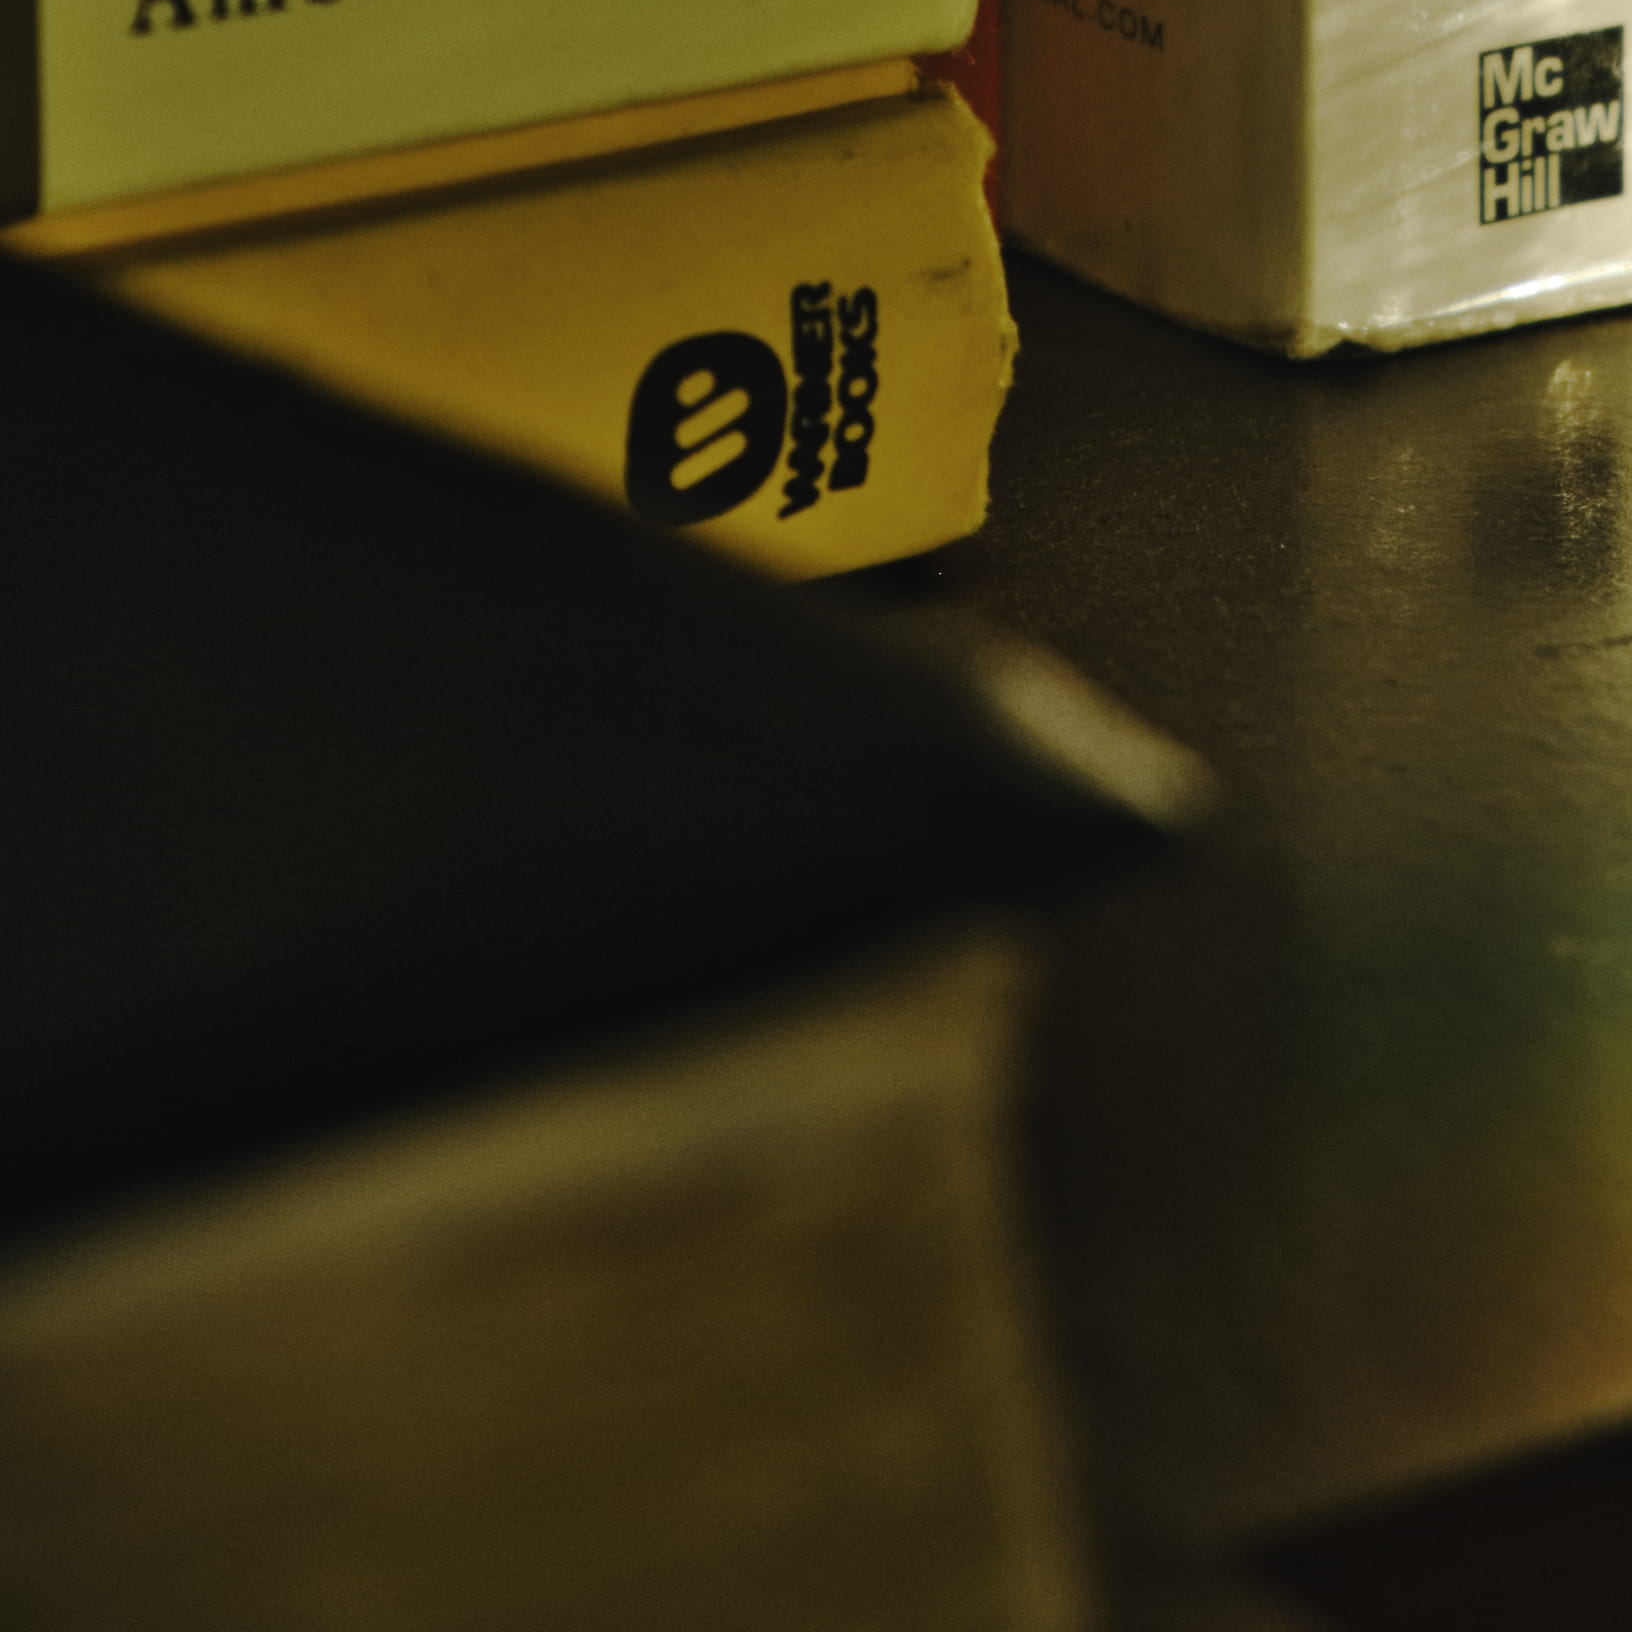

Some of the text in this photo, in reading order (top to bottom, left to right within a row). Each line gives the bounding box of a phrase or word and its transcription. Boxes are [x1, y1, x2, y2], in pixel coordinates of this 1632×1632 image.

[1482, 46, 1564, 109] Mc
[1482, 100, 1621, 164] Graw
[1483, 153, 1561, 222] Hill
